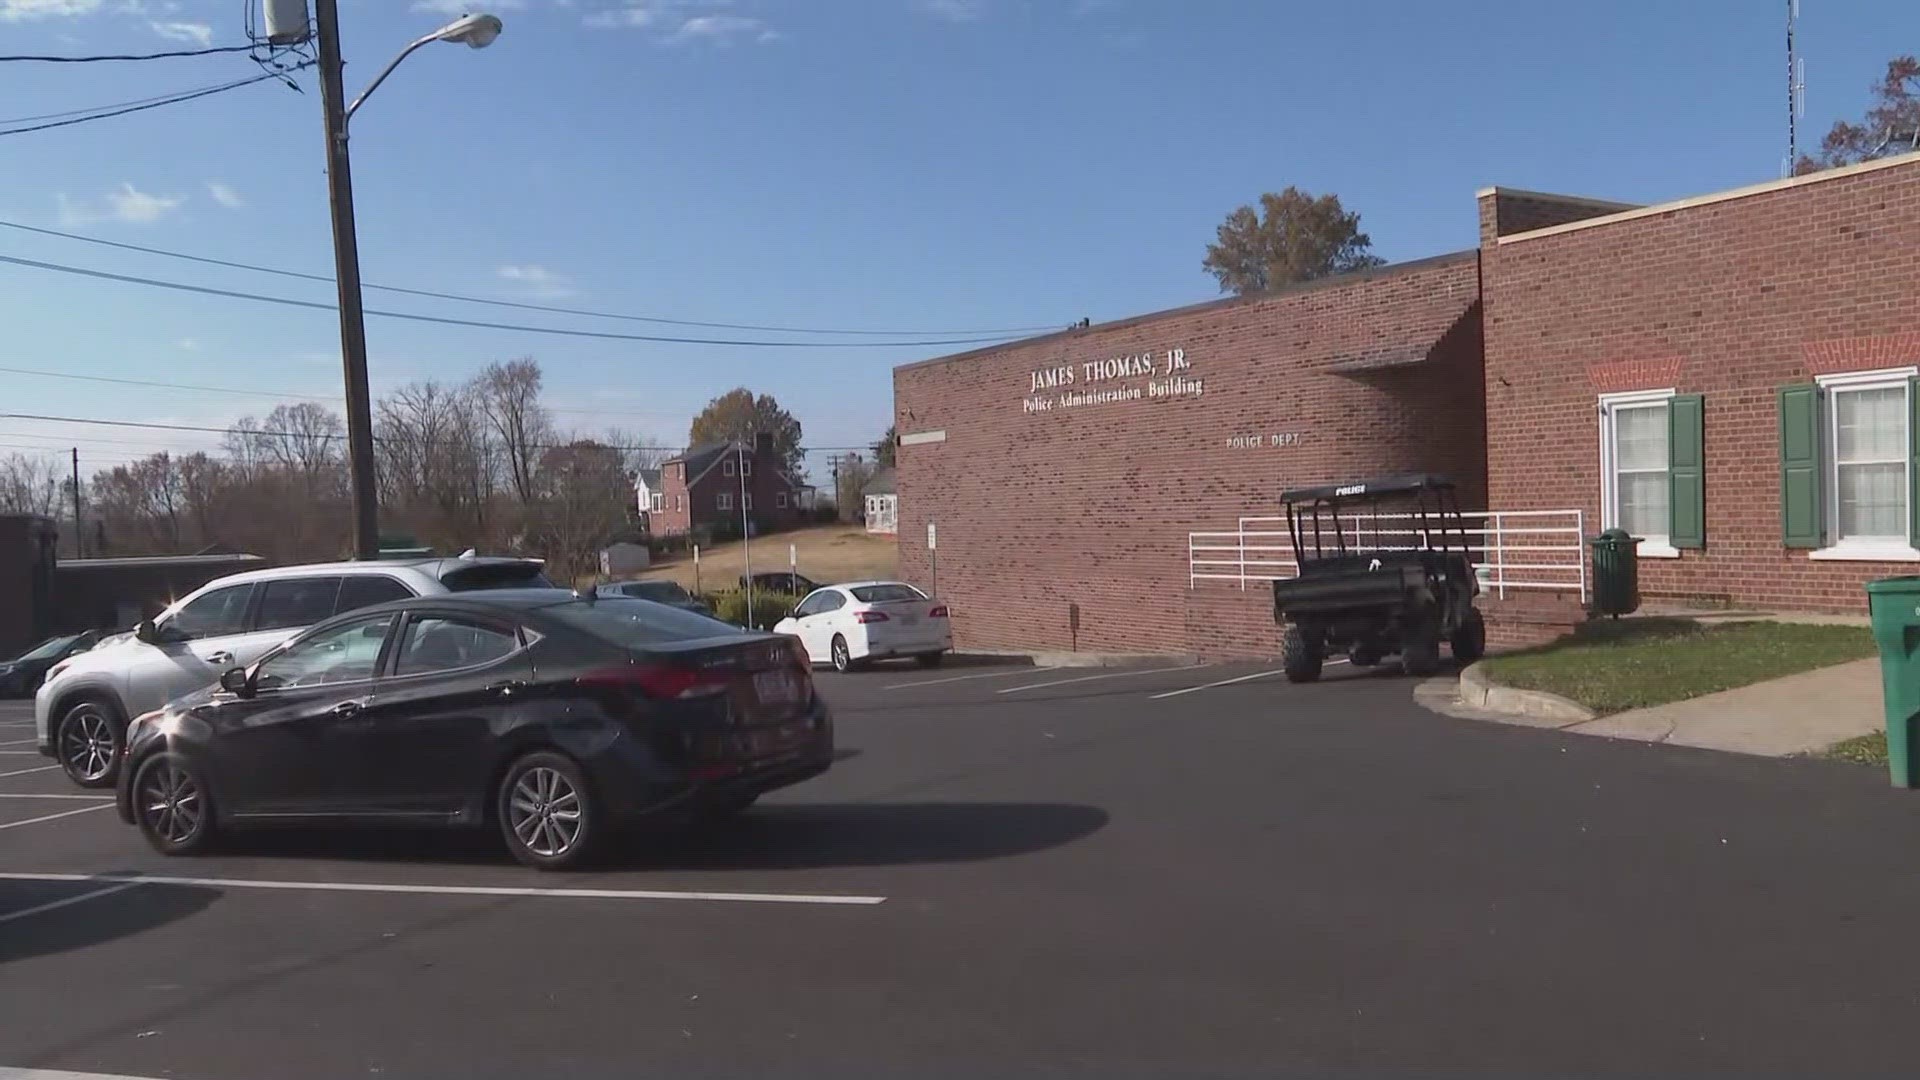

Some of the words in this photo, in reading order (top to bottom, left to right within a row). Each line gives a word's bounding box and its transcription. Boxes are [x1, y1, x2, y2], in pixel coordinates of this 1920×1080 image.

[1031, 366, 1075, 393] JAMES
[1083, 353, 1156, 381] THOMAS,
[1165, 348, 1191, 375] JR.
[1023, 397, 1053, 413] Police
[1059, 385, 1141, 408] Administration
[1149, 377, 1203, 397] Building
[1226, 436, 1263, 448] POLICE
[1335, 485, 1366, 496] POLICE
